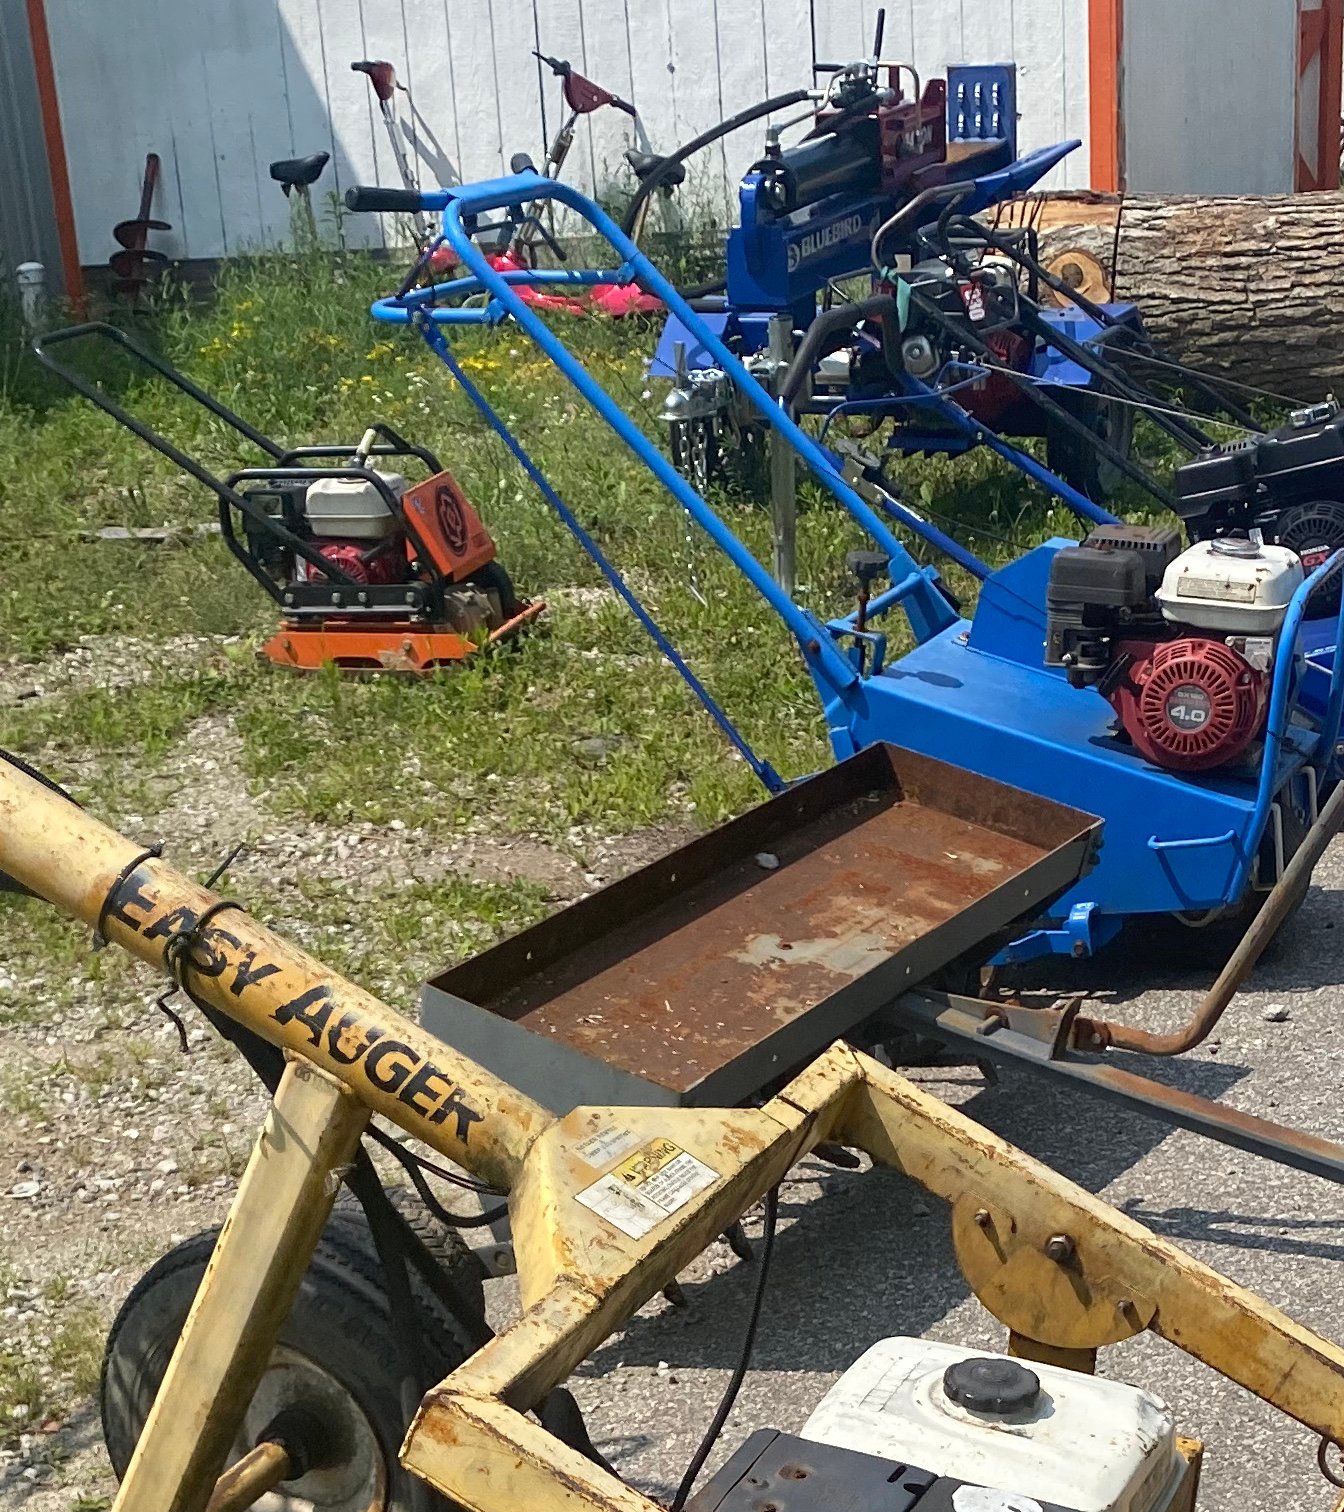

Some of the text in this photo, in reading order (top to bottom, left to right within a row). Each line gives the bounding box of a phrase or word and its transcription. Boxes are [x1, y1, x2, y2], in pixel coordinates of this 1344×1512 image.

[801, 214, 862, 257] BLUEBIRD
[1300, 545, 1330, 556] HONDA
[1170, 705, 1206, 722] 4.0
[107, 868, 486, 1146] EASY AUGER
